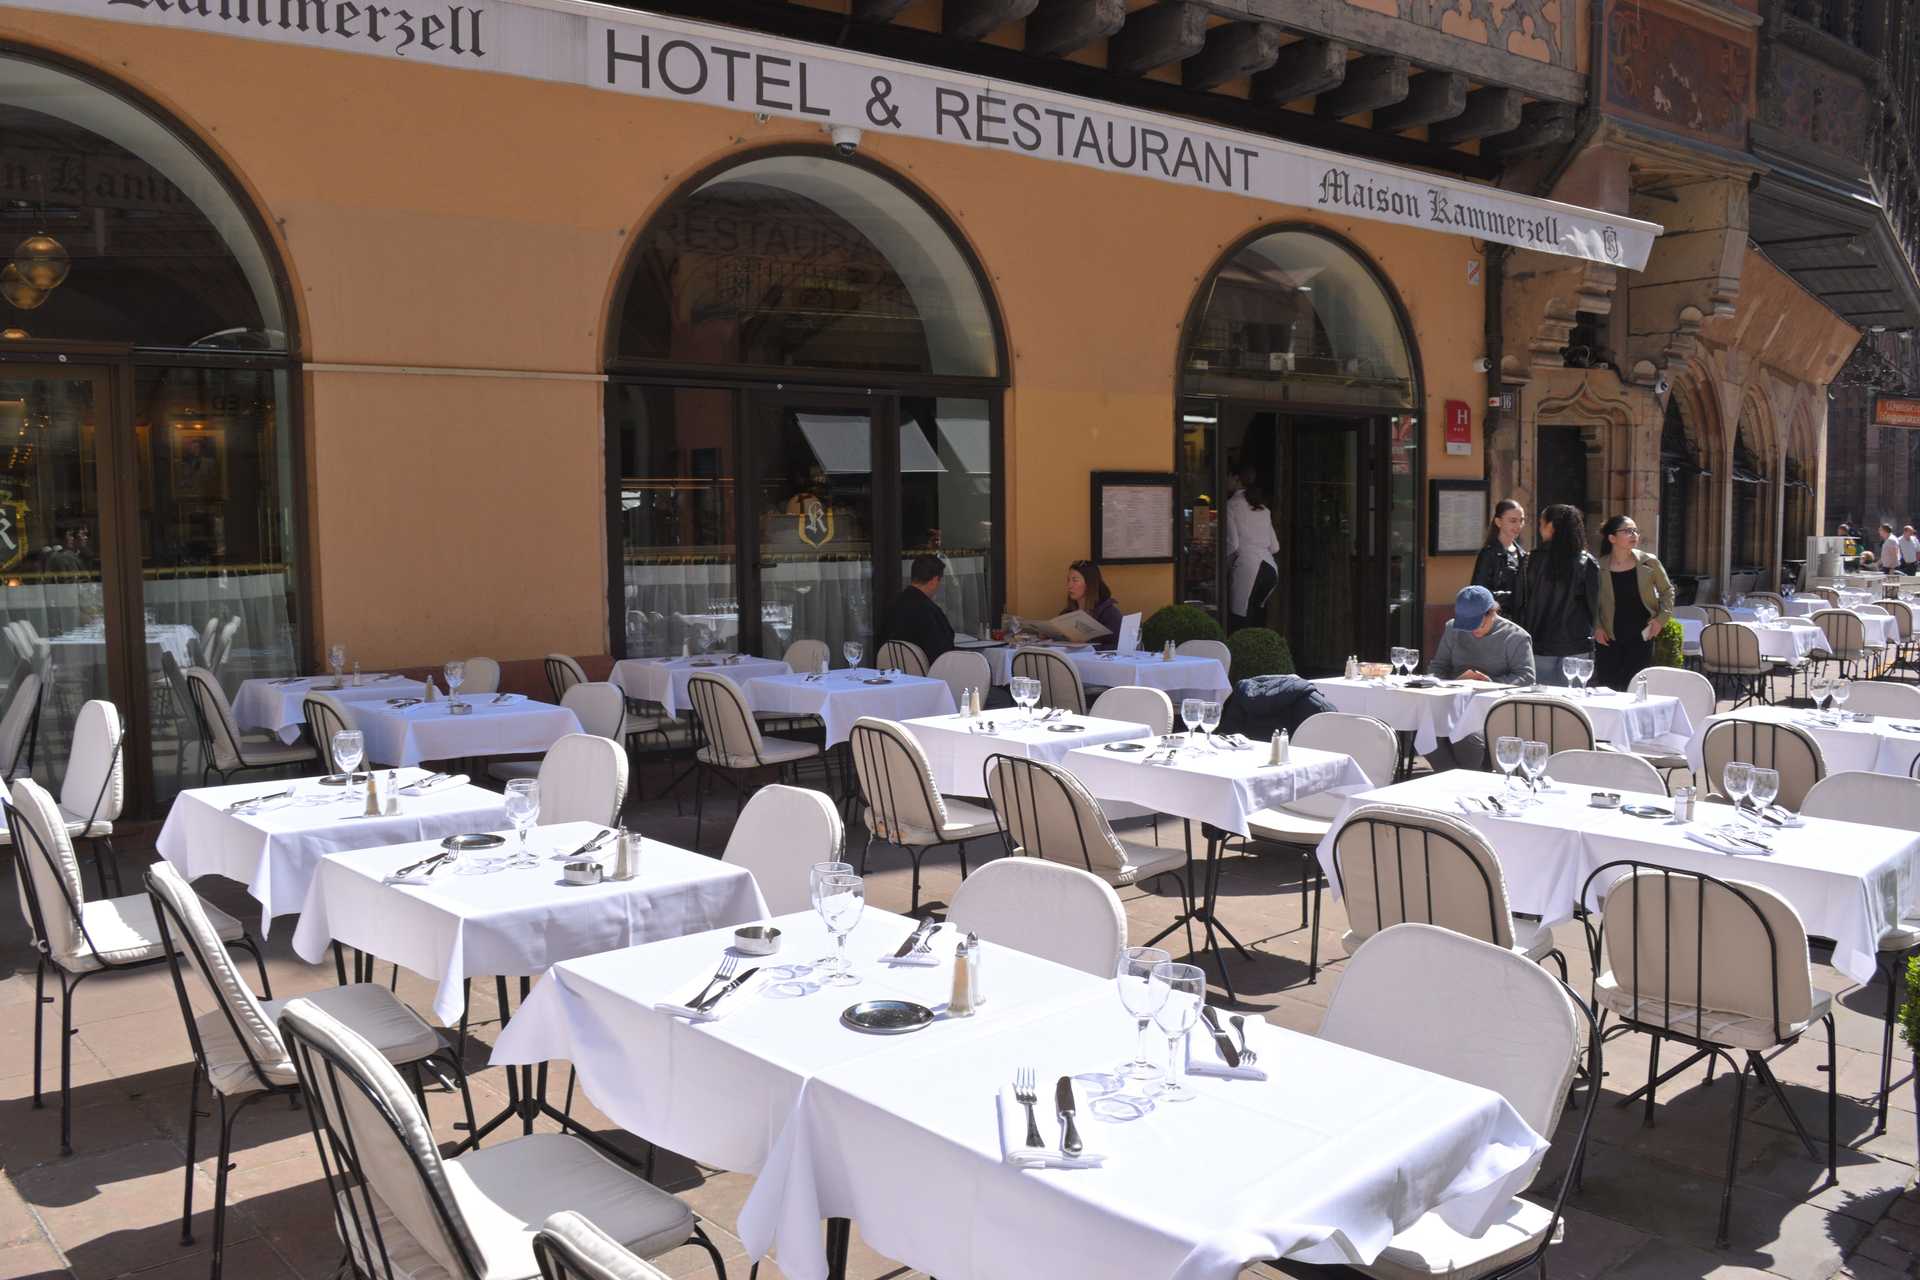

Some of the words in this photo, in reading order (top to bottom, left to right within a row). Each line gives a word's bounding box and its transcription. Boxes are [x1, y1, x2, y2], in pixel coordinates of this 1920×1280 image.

[107, 0, 486, 57] mmerzell
[606, 28, 831, 117] HOTEL
[865, 75, 902, 129] &
[935, 86, 1259, 191] RESTAURANT
[1318, 168, 1421, 217] Maison
[1427, 188, 1560, 246] Kammerzell
[1456, 408, 1468, 425] H
[1502, 392, 1512, 409] 16
